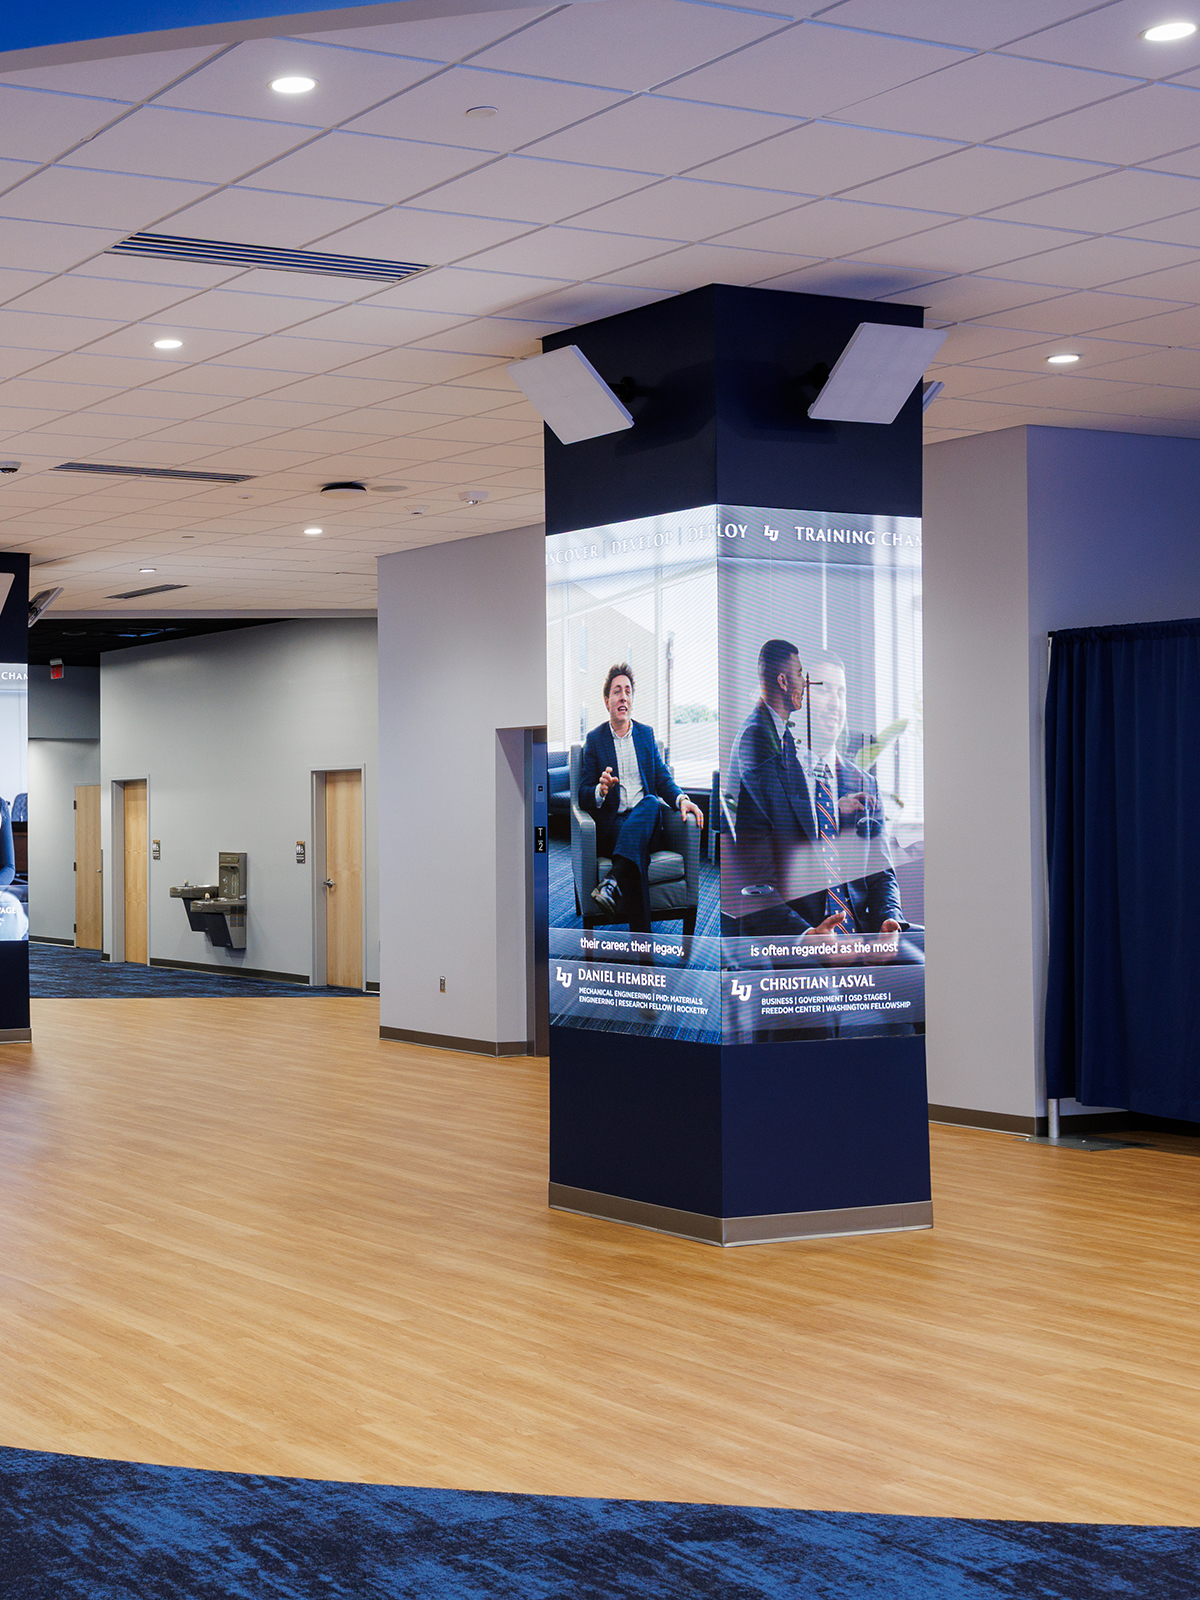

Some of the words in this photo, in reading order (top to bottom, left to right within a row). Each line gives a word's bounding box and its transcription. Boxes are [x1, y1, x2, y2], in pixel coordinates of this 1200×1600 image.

[612, 531, 673, 555] DEVELOP
[688, 523, 748, 543] DEPLOY
[794, 526, 876, 545] TRAINING
[538, 828, 543, 836] T
[538, 843, 543, 851] 2
[580, 937, 599, 949] their
[601, 940, 630, 953] career,
[631, 940, 651, 953] their
[653, 941, 685, 957] legacy,
[750, 944, 759, 957] is
[761, 944, 789, 956] often
[791, 942, 838, 957] regarded
[840, 944, 851, 953] as
[853, 941, 871, 953] the
[873, 941, 898, 953] most
[578, 968, 615, 983] DANIEL
[617, 972, 667, 988] HEMBREE
[759, 976, 829, 991] CHRISTIAN
[832, 974, 875, 988] LASVAL
[578, 987, 613, 997] MECHANICAL
[614, 990, 651, 1000] ENGINEERING
[655, 994, 670, 1002] PHD:
[670, 995, 703, 1005] MATERIALS
[761, 997, 793, 1006] BUSINESS
[798, 994, 843, 1004] GOVERNMENT
[848, 993, 863, 1002] OSD
[863, 992, 888, 1001] STAGES
[578, 995, 615, 1006] ENGINEERING
[618, 999, 648, 1009] RESEARCH
[649, 1002, 673, 1012] FELLOW
[676, 1006, 708, 1015] ROCKETRY
[761, 1006, 794, 1015] FREEDOM
[795, 1005, 821, 1013] CENTER
[825, 1002, 869, 1012] WASHINGTON
[870, 1001, 911, 1010] FELLOWSHIP
